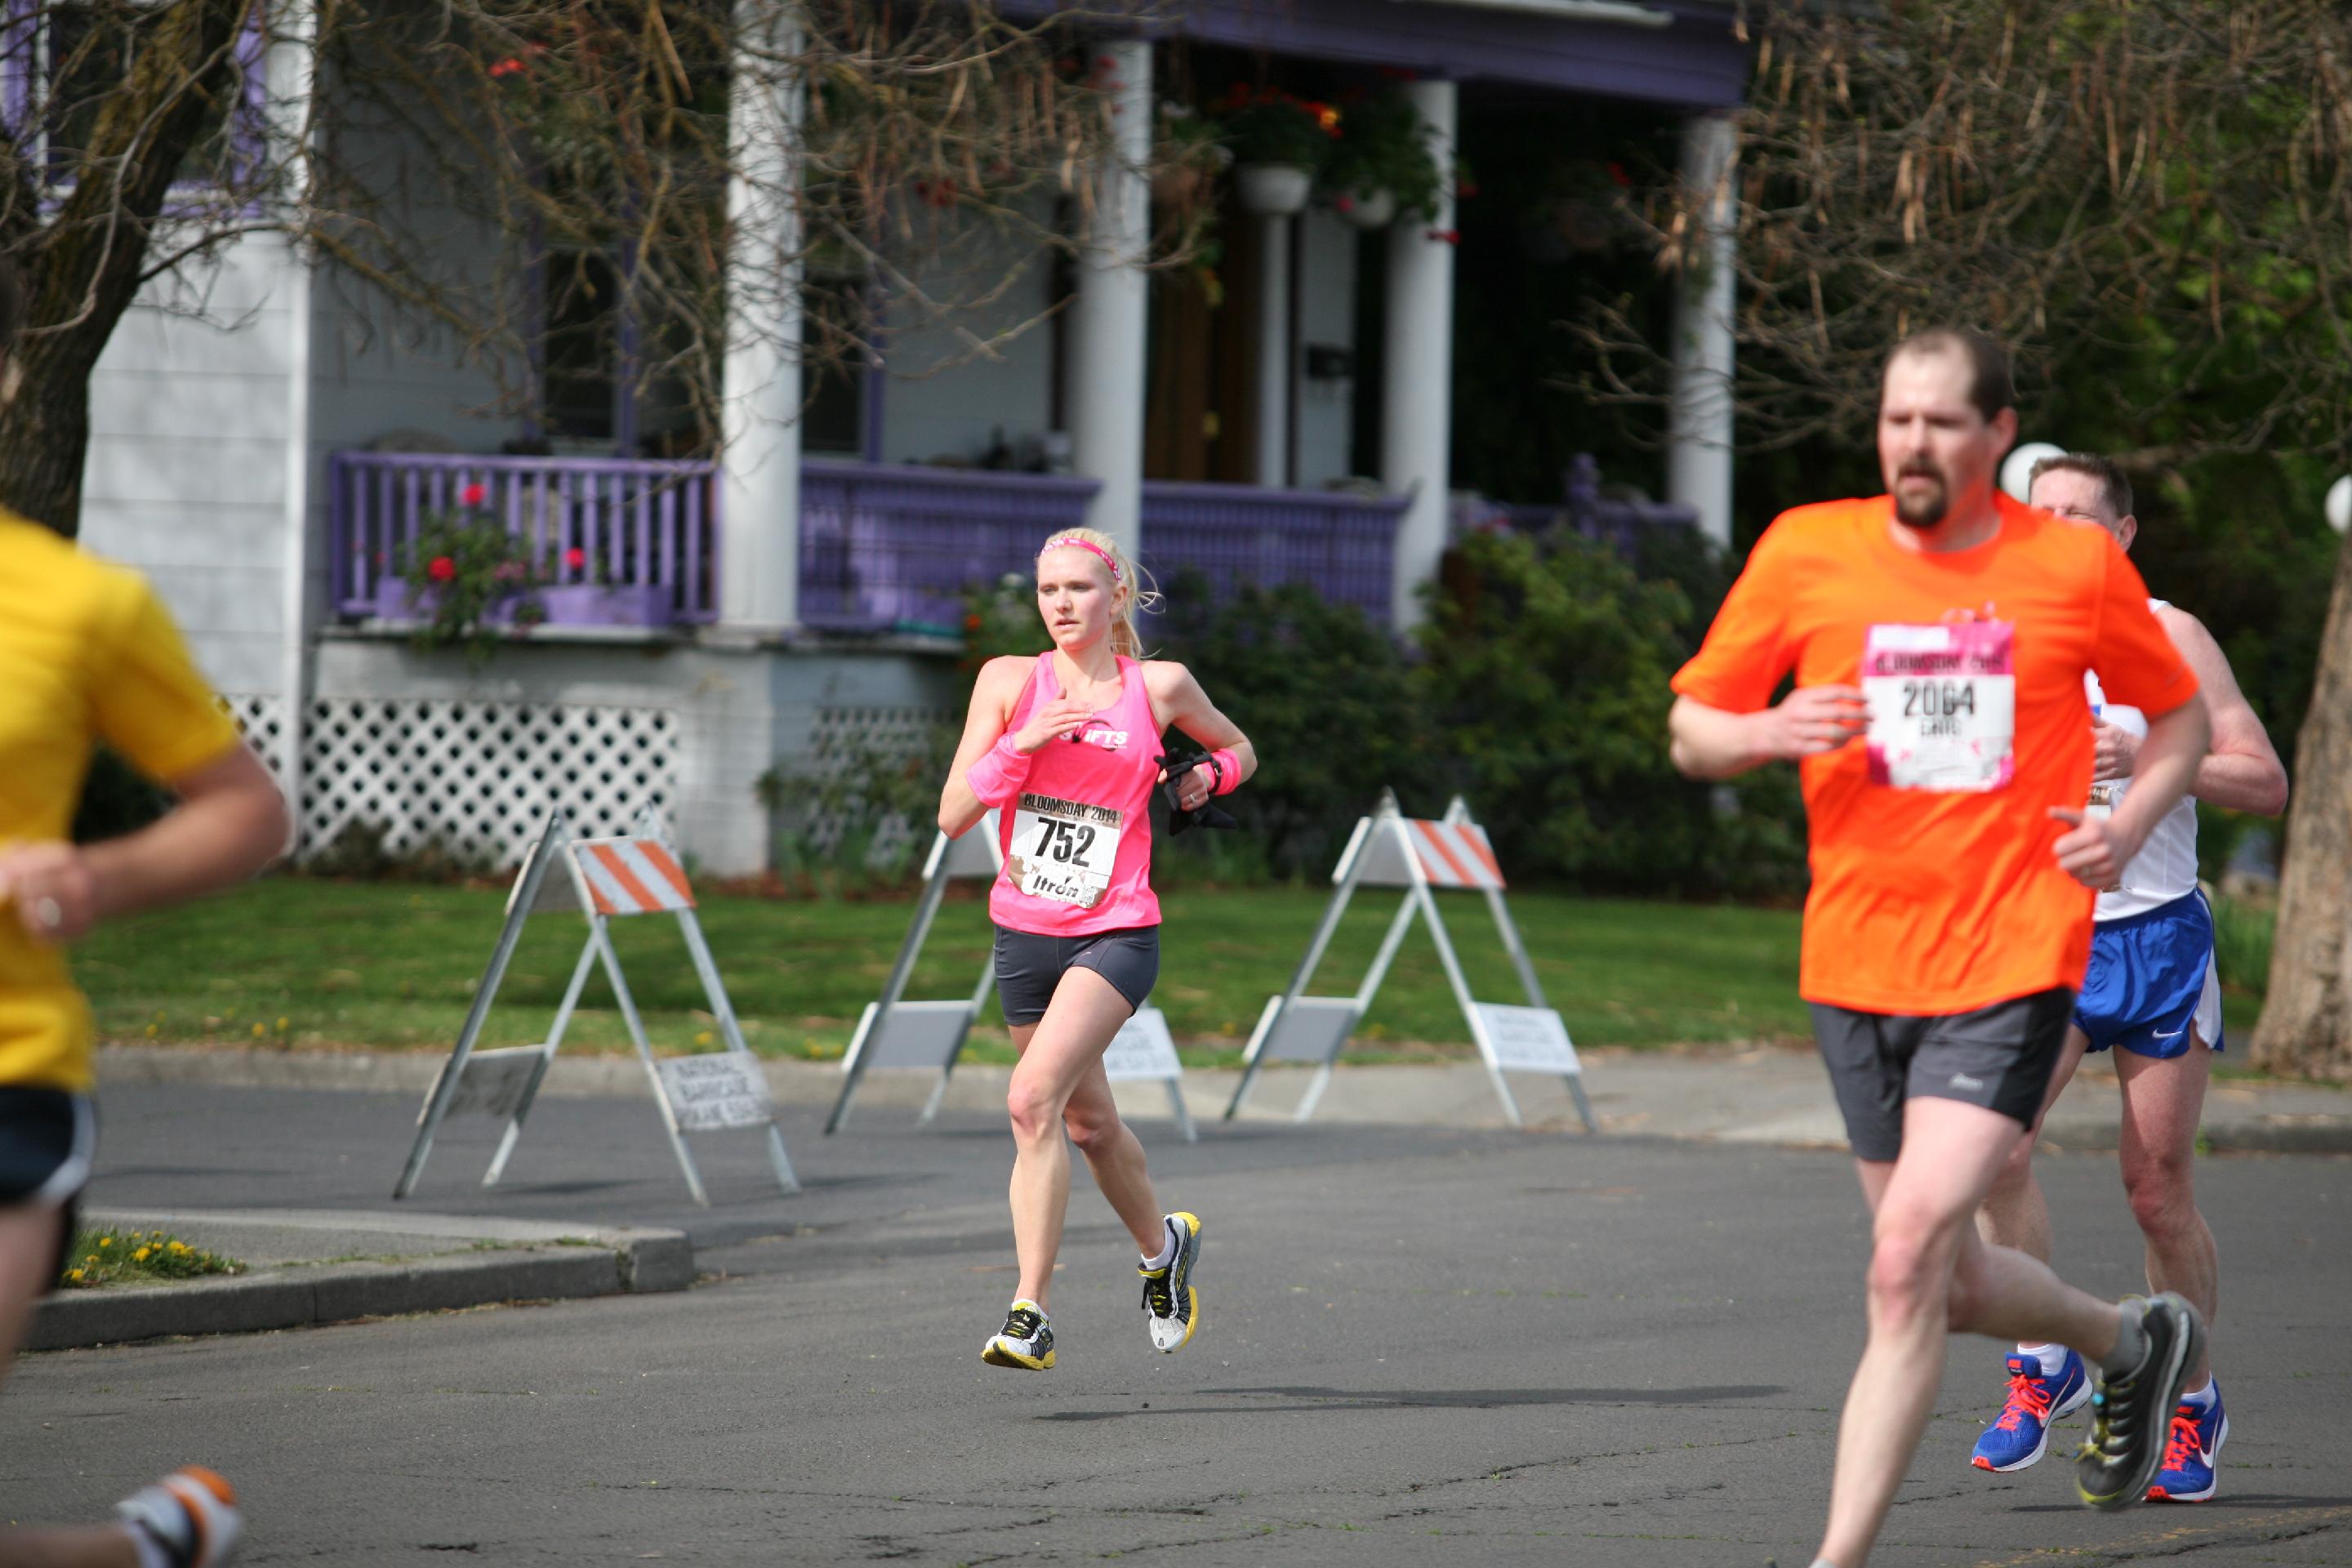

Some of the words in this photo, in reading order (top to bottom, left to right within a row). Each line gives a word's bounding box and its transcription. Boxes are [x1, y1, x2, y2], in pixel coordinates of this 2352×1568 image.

[1904, 679, 1974, 716] 2064
[1024, 793, 1088, 817] BLOOMSDAY
[1091, 806, 1117, 823] 2014
[1035, 817, 1096, 867] 752
